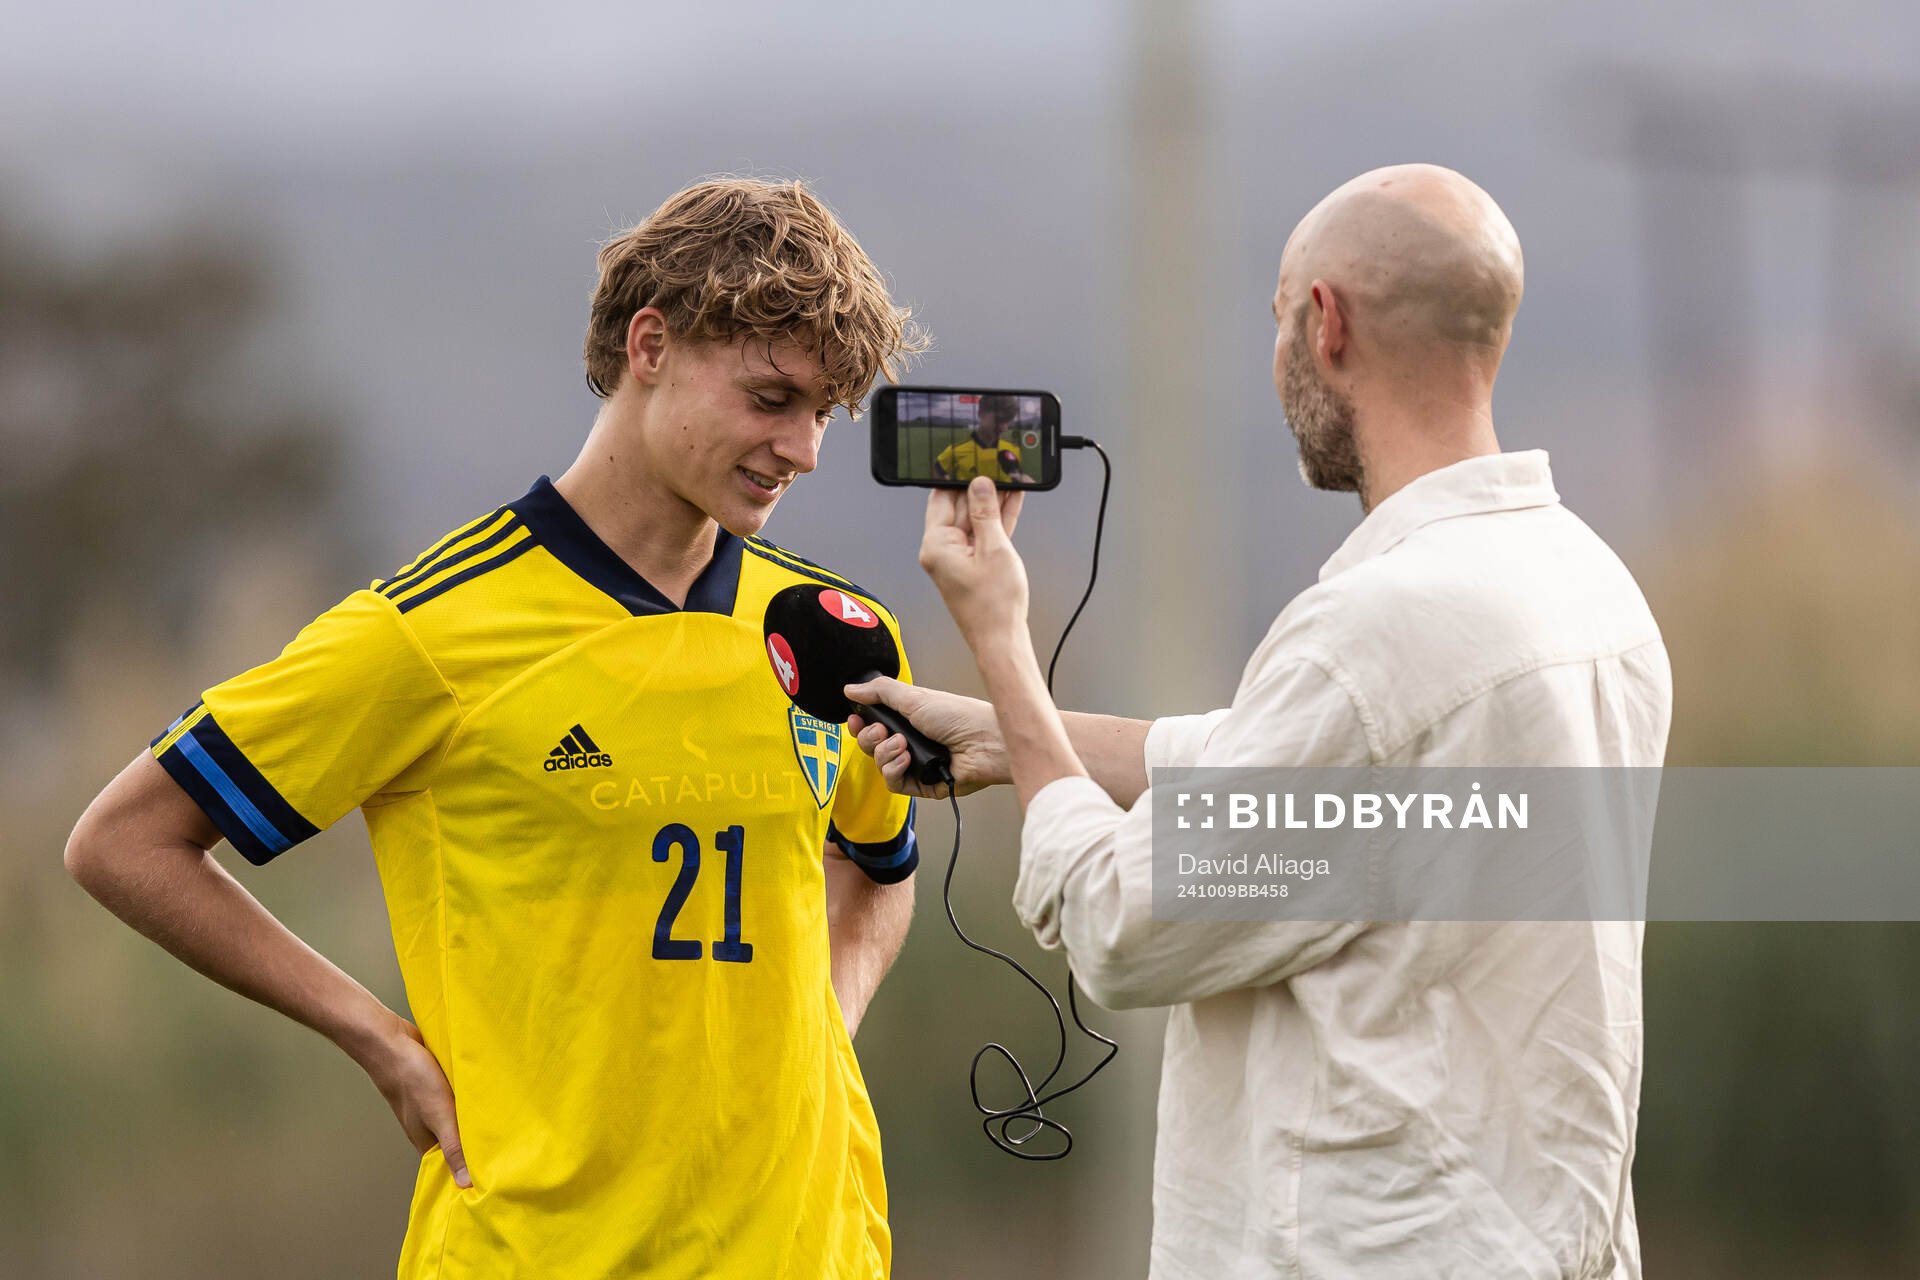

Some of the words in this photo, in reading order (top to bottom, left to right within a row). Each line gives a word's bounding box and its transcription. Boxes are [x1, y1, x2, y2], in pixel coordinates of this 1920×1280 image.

[838, 591, 871, 623] 4
[768, 638, 795, 692] 4
[801, 717, 836, 734] SVERIGE
[543, 751, 613, 773] adidas
[590, 770, 800, 811] CATAPULT
[651, 822, 754, 964] 21
